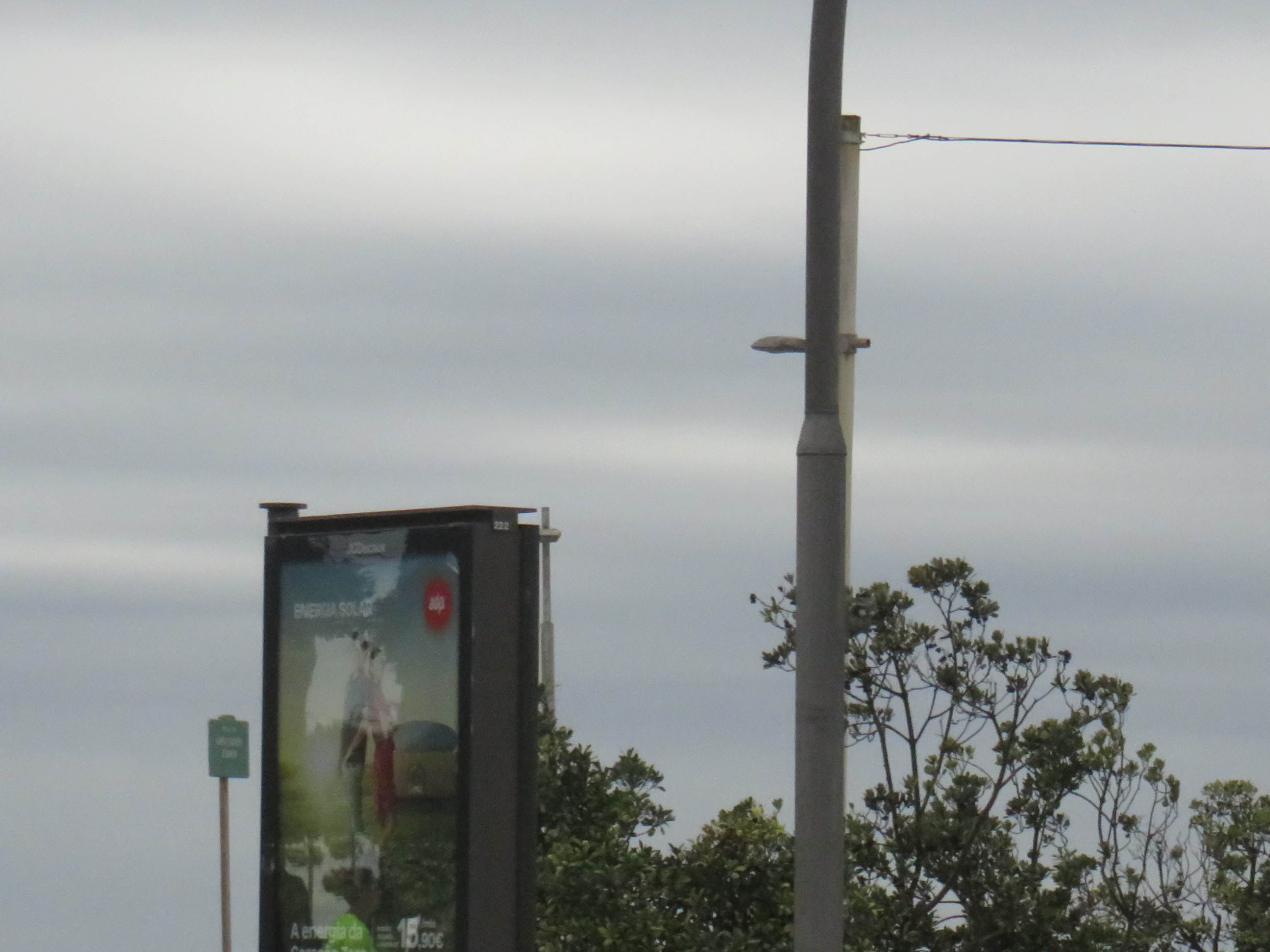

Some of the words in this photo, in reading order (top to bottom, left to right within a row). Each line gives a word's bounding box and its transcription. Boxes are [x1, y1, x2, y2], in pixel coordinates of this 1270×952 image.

[493, 521, 510, 530] 222
[291, 923, 300, 939] A
[302, 924, 346, 943] energia
[350, 923, 363, 940] da
